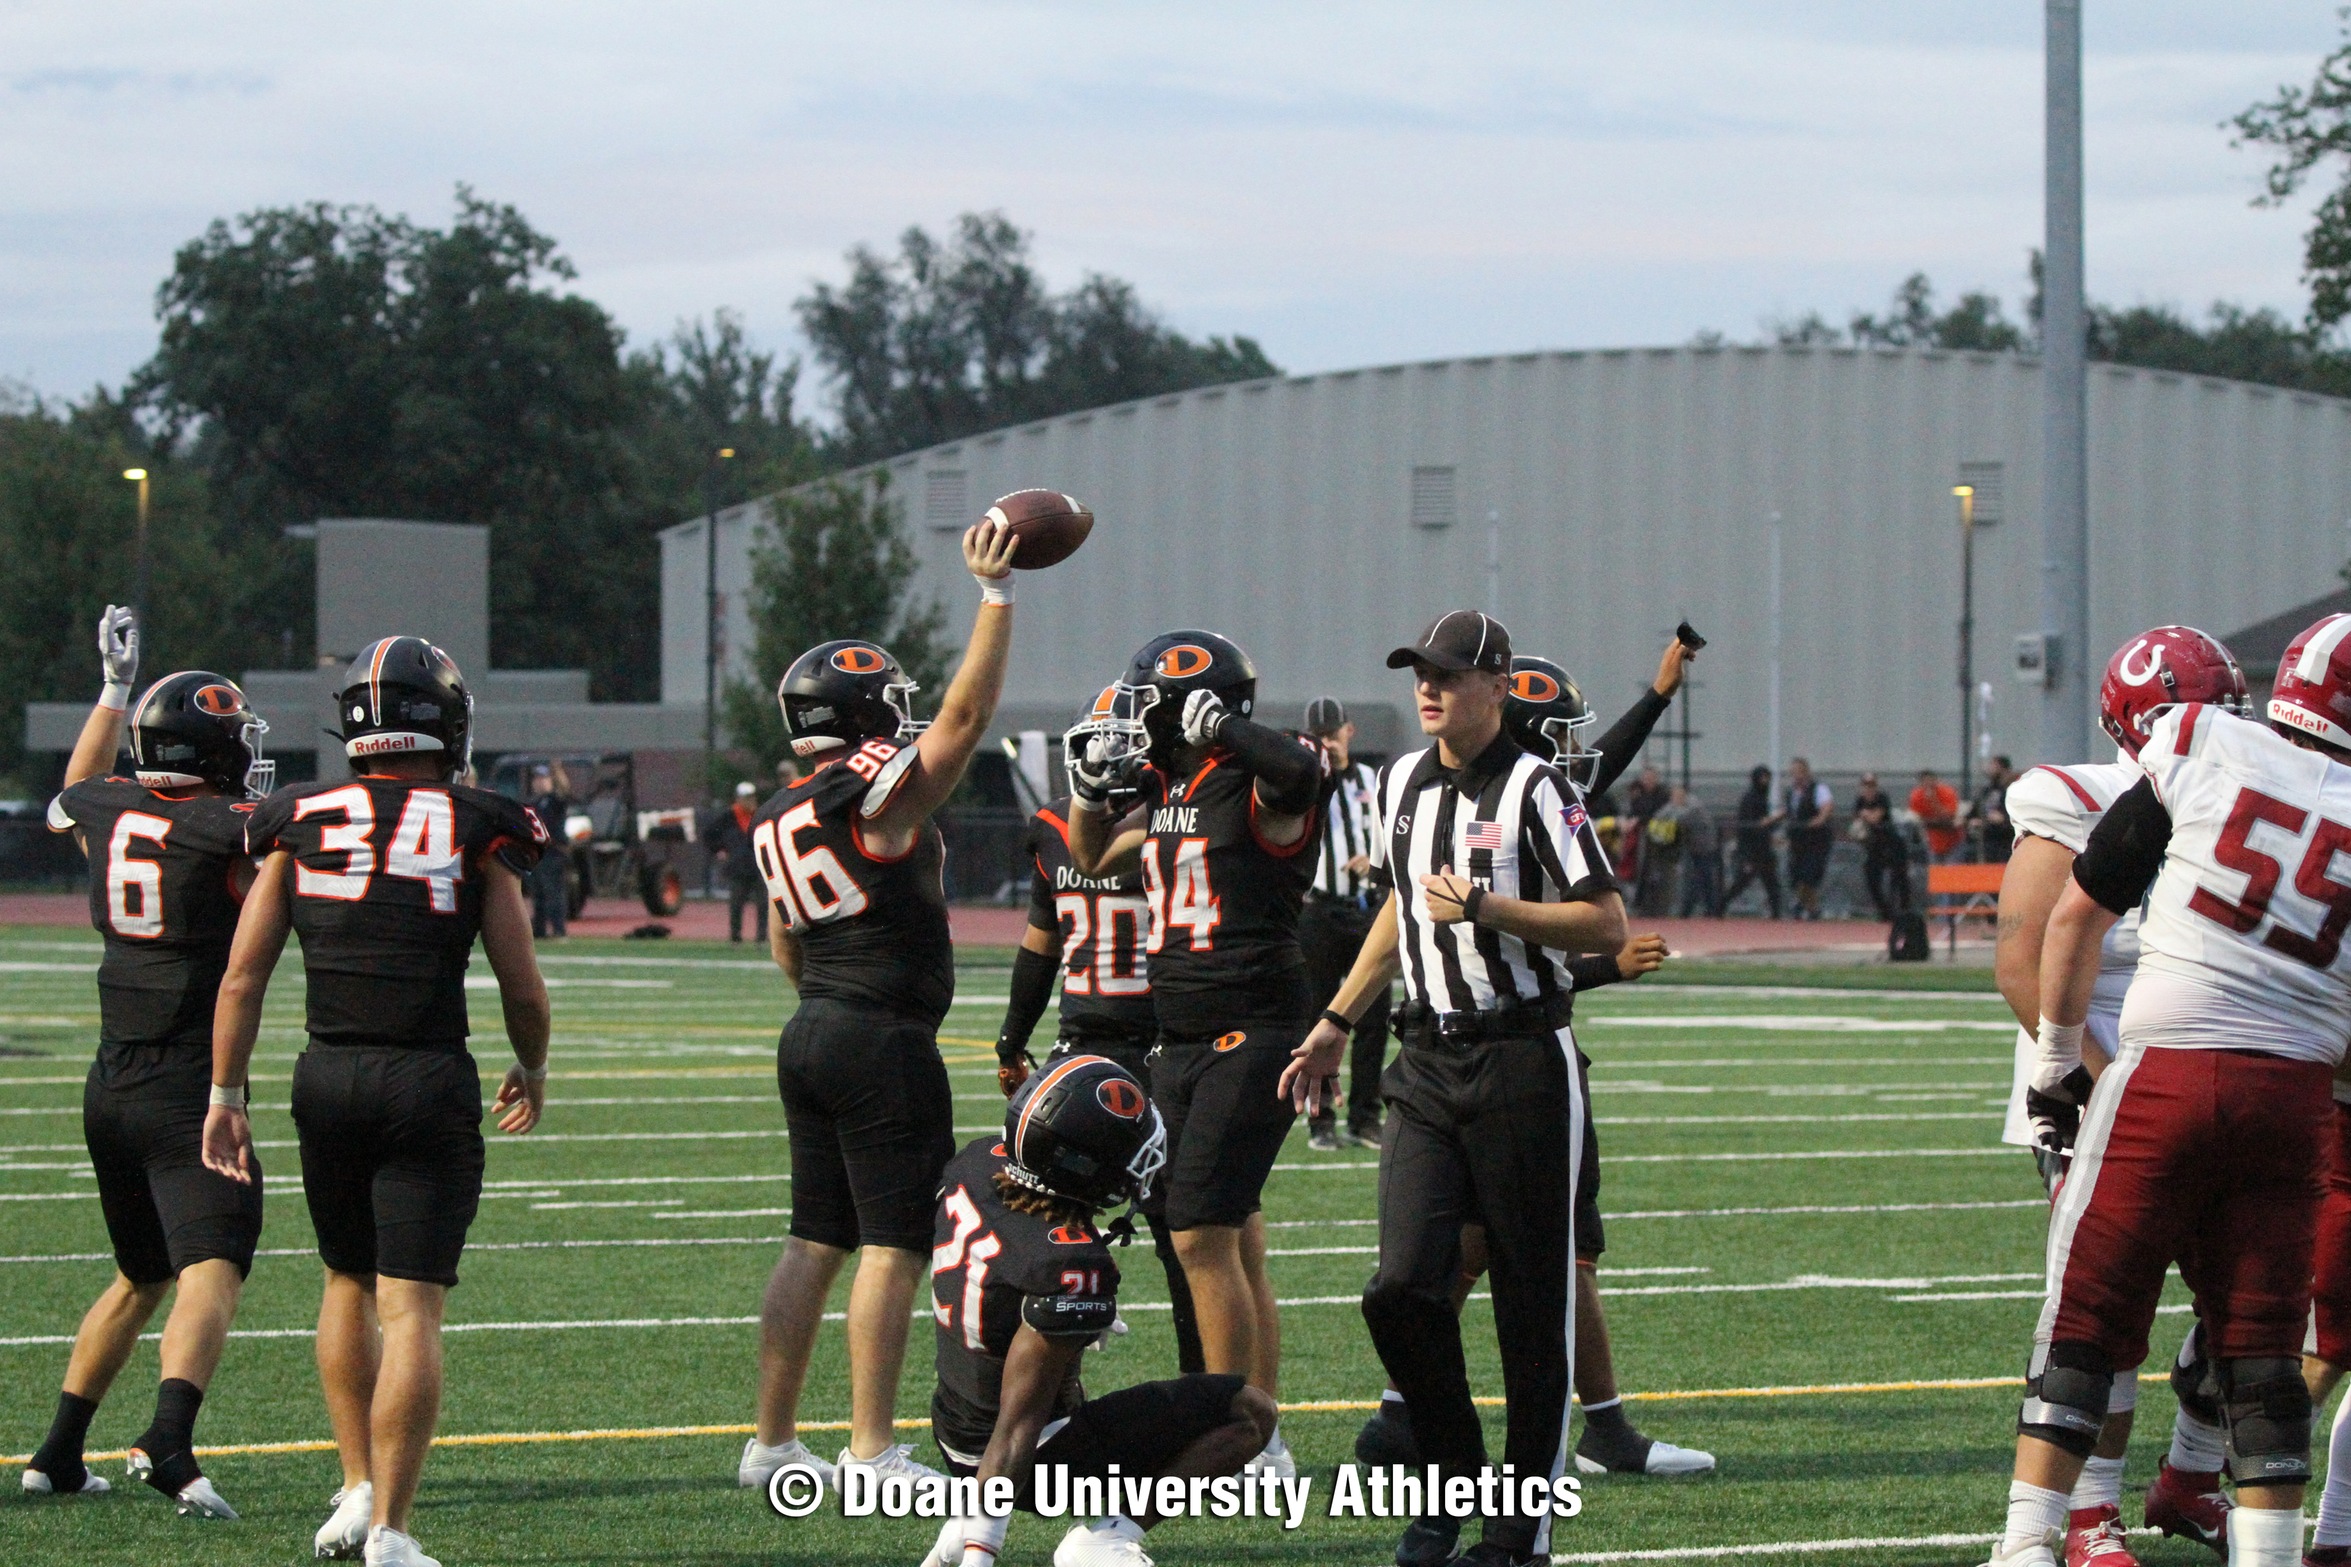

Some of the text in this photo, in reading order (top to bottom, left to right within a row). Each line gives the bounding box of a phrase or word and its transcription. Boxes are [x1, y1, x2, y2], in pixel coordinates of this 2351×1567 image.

[354, 736, 416, 755] Riddell
[2272, 703, 2329, 734] Riddell
[845, 738, 900, 783] 96
[293, 783, 465, 915] 34
[1150, 806, 1199, 834] DOANE
[1395, 814, 1411, 835] S
[106, 809, 174, 939] 6
[753, 797, 869, 930] 96
[1141, 837, 1222, 955] 94
[2184, 785, 2351, 971] 55
[1053, 892, 1152, 996] 20
[931, 1184, 1002, 1350] 21
[1061, 1270, 1101, 1296] 21
[1056, 1301, 1107, 1312] SPORTS
